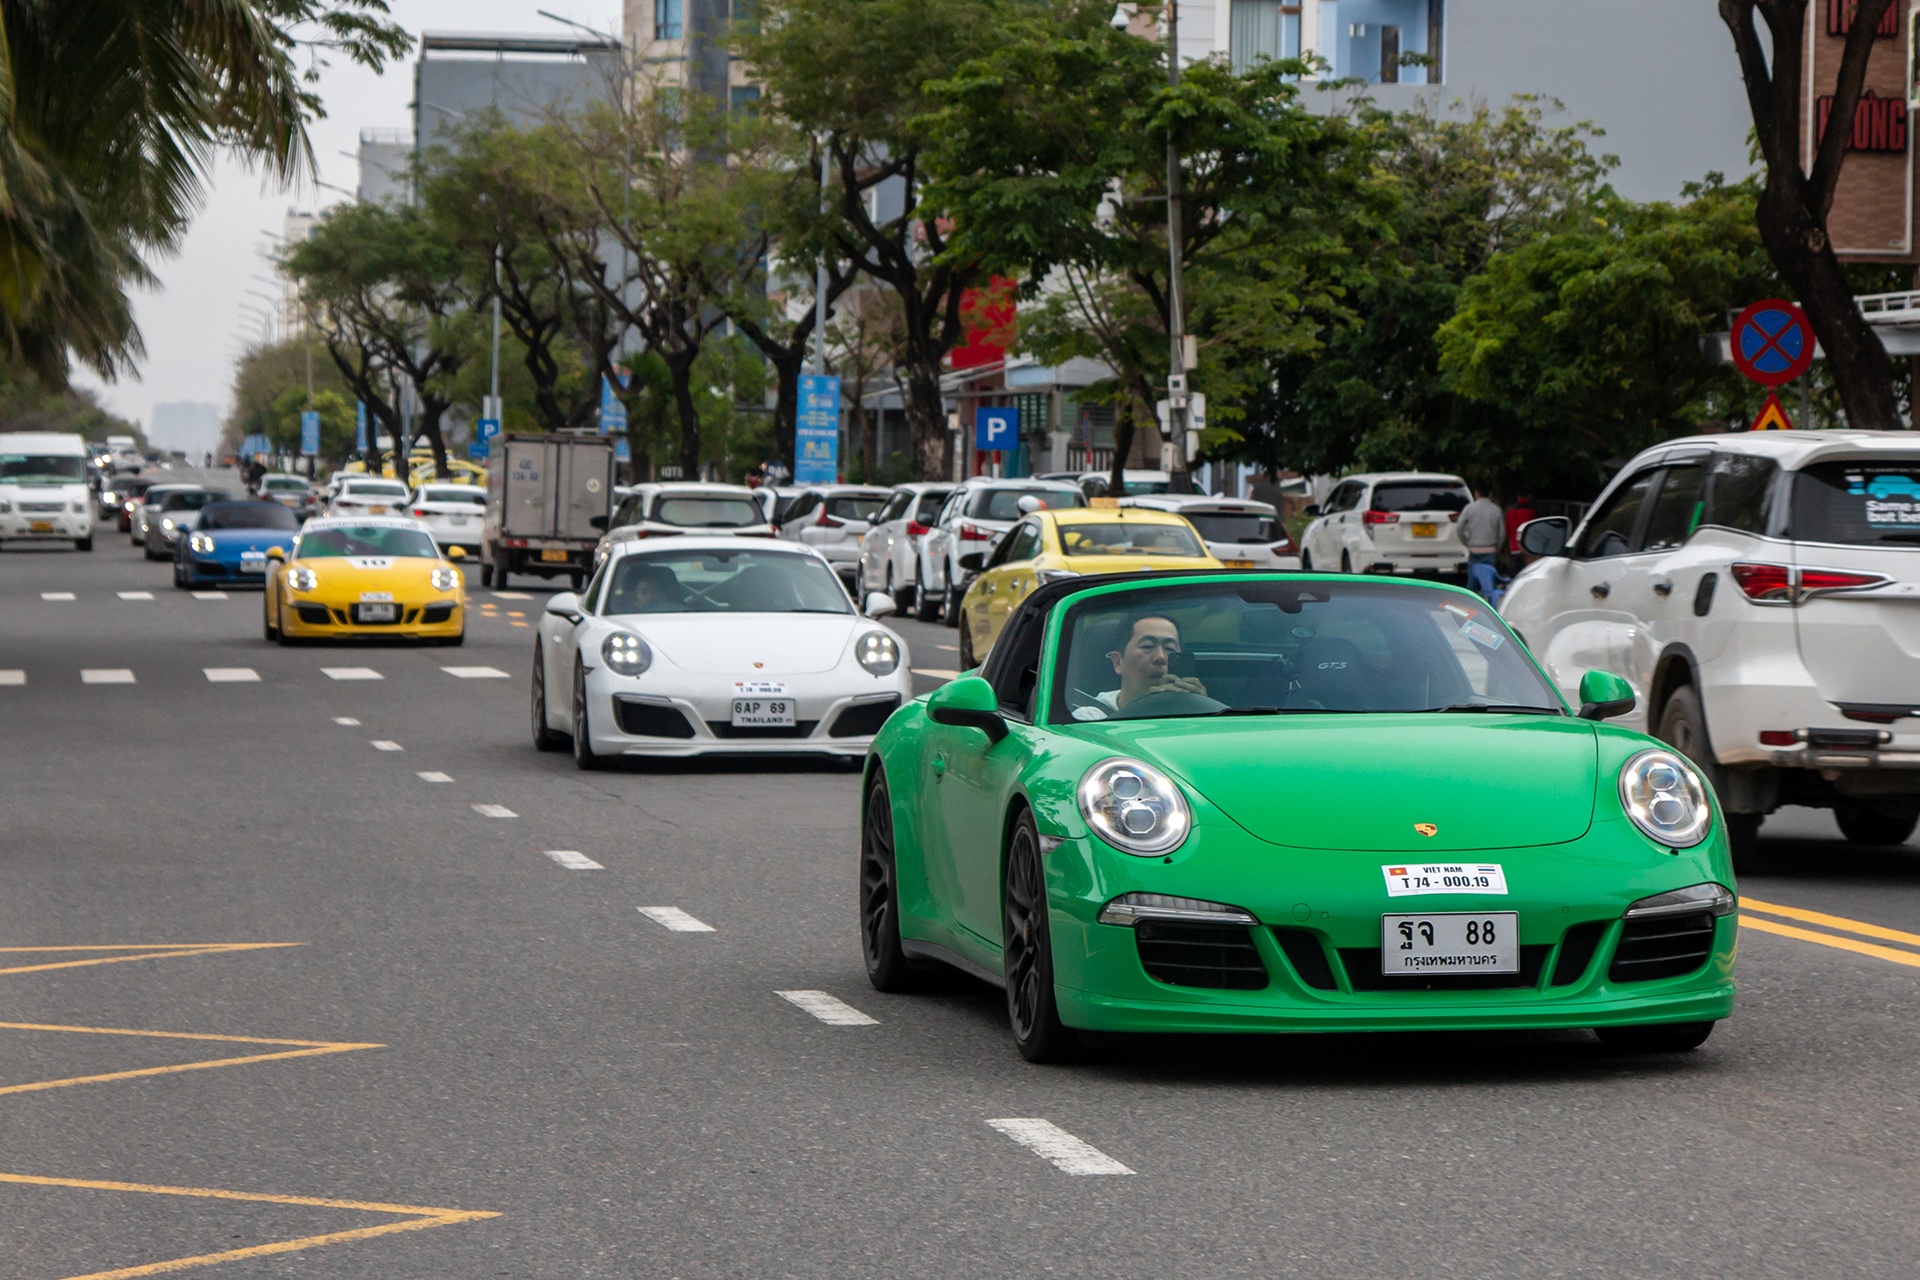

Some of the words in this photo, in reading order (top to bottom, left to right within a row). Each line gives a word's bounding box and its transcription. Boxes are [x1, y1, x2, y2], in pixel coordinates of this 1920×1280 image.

[484, 424, 495, 436] P
[987, 417, 1007, 441] P
[1317, 661, 1348, 670] GTS
[735, 702, 761, 714] 6AP
[769, 702, 786, 714] 69
[741, 716, 783, 724] THAILAND
[1401, 877, 1410, 889] T
[1413, 876, 1431, 888] 74
[1442, 875, 1490, 888] 000.19
[1466, 920, 1496, 945] 88
